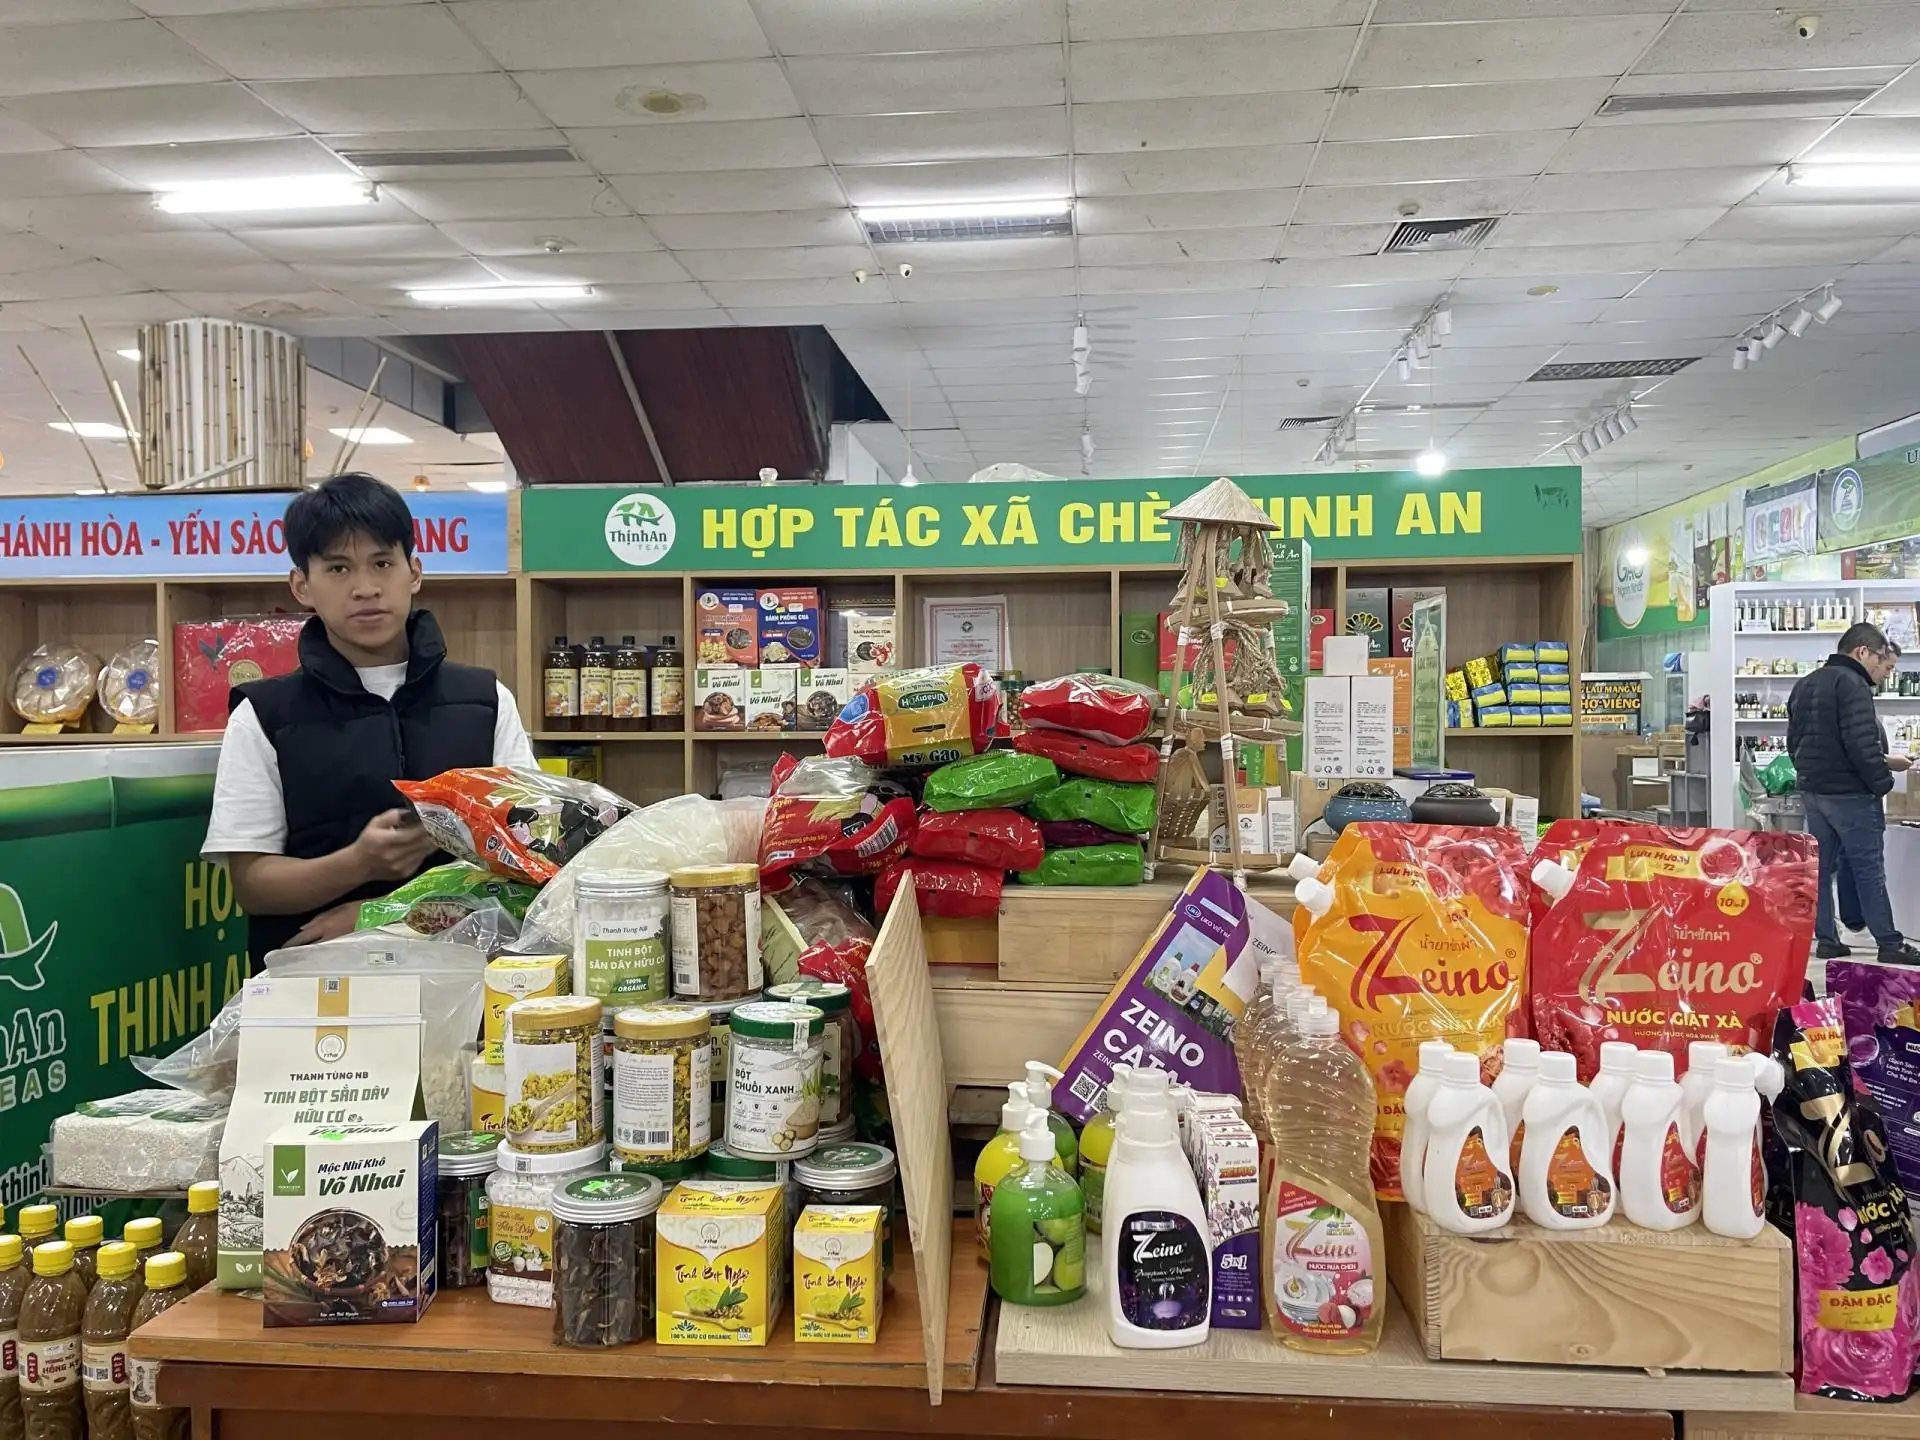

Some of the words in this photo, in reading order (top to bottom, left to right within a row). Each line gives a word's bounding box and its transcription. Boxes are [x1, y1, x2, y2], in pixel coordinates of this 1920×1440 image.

[81, 512, 143, 556] HÒA
[169, 508, 220, 554] YẾN
[231, 512, 288, 554] SÀO
[412, 517, 469, 553] ANG
[703, 504, 813, 557] HỢP
[834, 498, 940, 548] TÁC
[962, 495, 1038, 546] XÃ
[1060, 492, 1171, 543] CHÈ
[1252, 494, 1373, 539] INH
[1396, 491, 1481, 535] AN
[609, 530, 667, 545] ThịnhAn
[606, 948, 632, 957] TINH
[635, 944, 653, 957] BỘT
[610, 959, 632, 969] DÂY
[1349, 913, 1518, 1013] Zeino
[617, 983, 648, 993] ORGANIC
[1607, 1007, 1665, 1024] NƯỚC
[1120, 998, 1204, 1067] ZEINO
[290, 1072, 324, 1081] THANH
[327, 1069, 353, 1081] TÙNG
[355, 1072, 369, 1080] NB
[735, 1068, 752, 1081] BỘT
[263, 1091, 296, 1104] TINH
[299, 1086, 328, 1106] BỘT
[361, 1084, 390, 1102] DÂY
[765, 1085, 795, 1095] XANH
[294, 1108, 324, 1124] HỮU
[327, 1108, 347, 1124] CƠ
[318, 1161, 340, 1174] Mộc
[364, 1157, 386, 1168] Khô
[319, 1176, 346, 1196] Võ
[350, 1169, 406, 1194] Nhai
[1132, 1232, 1184, 1264] Zeino
[1829, 1297, 1863, 1311] ĐẬM
[1866, 1293, 1892, 1309] ĐẶC
